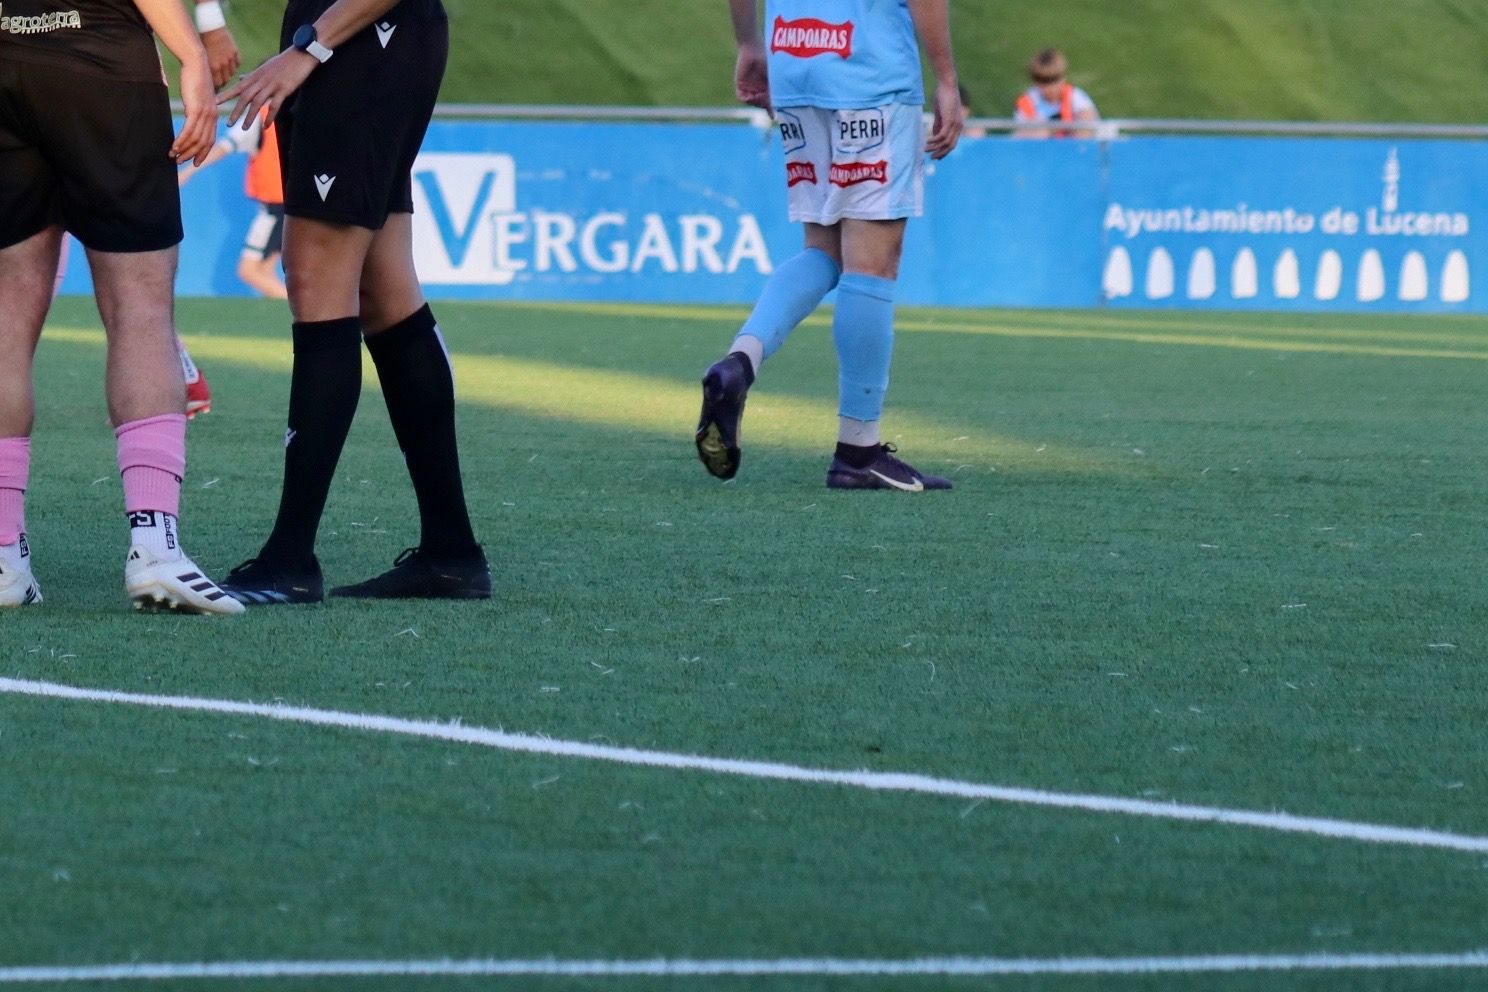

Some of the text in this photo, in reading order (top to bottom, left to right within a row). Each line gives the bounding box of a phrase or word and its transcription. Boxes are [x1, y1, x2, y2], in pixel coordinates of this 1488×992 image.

[0, 10, 81, 34] agroterra
[774, 26, 848, 50] CAMPOARAS
[414, 169, 774, 275] VERGARA
[1103, 202, 1470, 239] Ayuntamiento de Lucena
